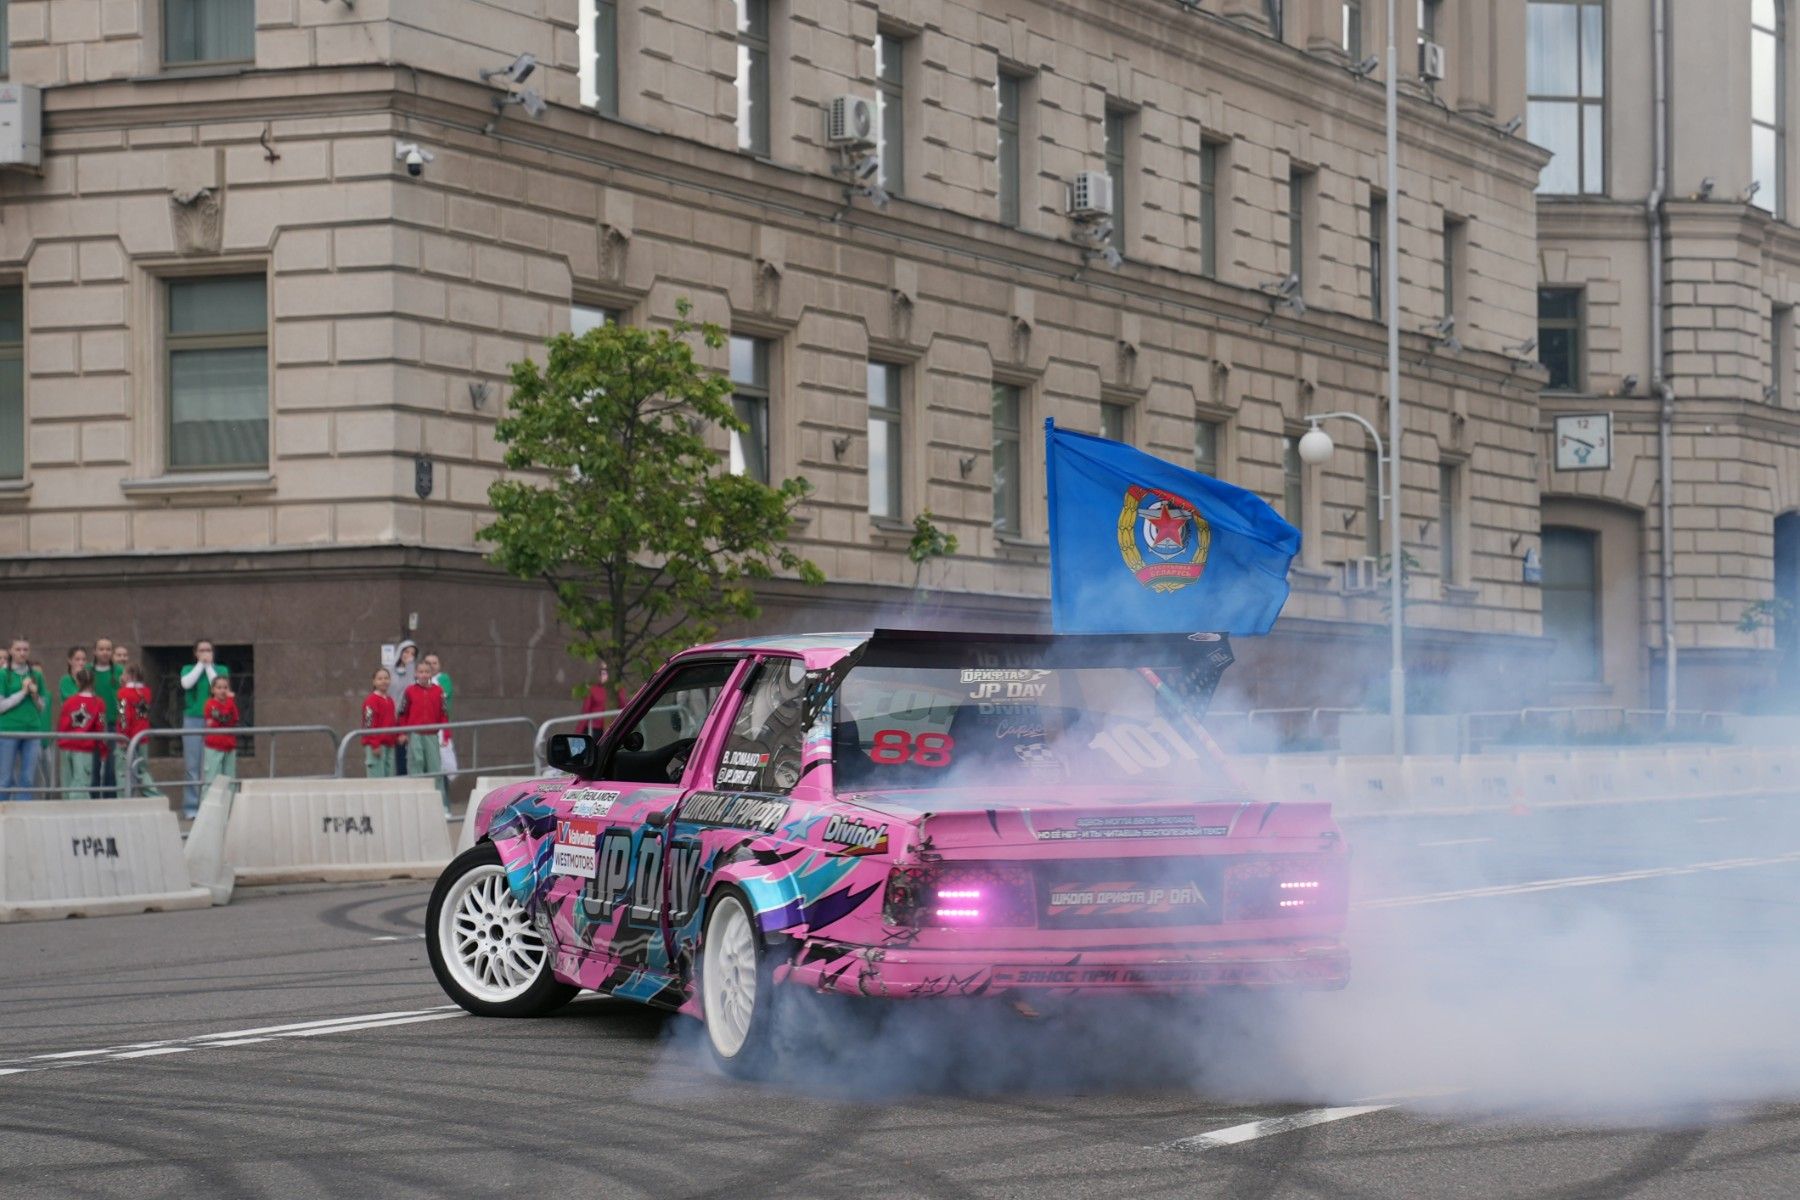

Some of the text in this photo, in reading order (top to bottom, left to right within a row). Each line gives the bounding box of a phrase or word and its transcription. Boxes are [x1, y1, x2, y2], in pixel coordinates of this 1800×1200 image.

[1577, 420, 1590, 429] 12
[969, 682, 1049, 699] JP DAY
[871, 729, 955, 768] 88
[1088, 716, 1199, 776] 101
[680, 794, 789, 830] ШКОЛА ДРИФТА
[323, 817, 374, 835] ГРАД
[823, 816, 889, 849] Divinol
[1038, 831, 1051, 839] НО
[1062, 830, 1078, 838] НЕТ
[1104, 829, 1141, 837] ЧИТАЕШЬ
[1142, 828, 1202, 837] БЕСПОЛЕЗНЫЙ
[1203, 827, 1227, 836] ТЕКСТ
[568, 829, 596, 847] Valvoline
[72, 836, 119, 859] ГРАД
[555, 852, 594, 871] WESTMOTORS
[587, 832, 632, 916] JP
[1051, 892, 1093, 905] ШКОЛА
[1096, 891, 1144, 905] ДРИФТА
[1147, 889, 1164, 905] JP
[1017, 970, 1076, 983] ЗАНОС
[1081, 970, 1118, 983] ПРИ
